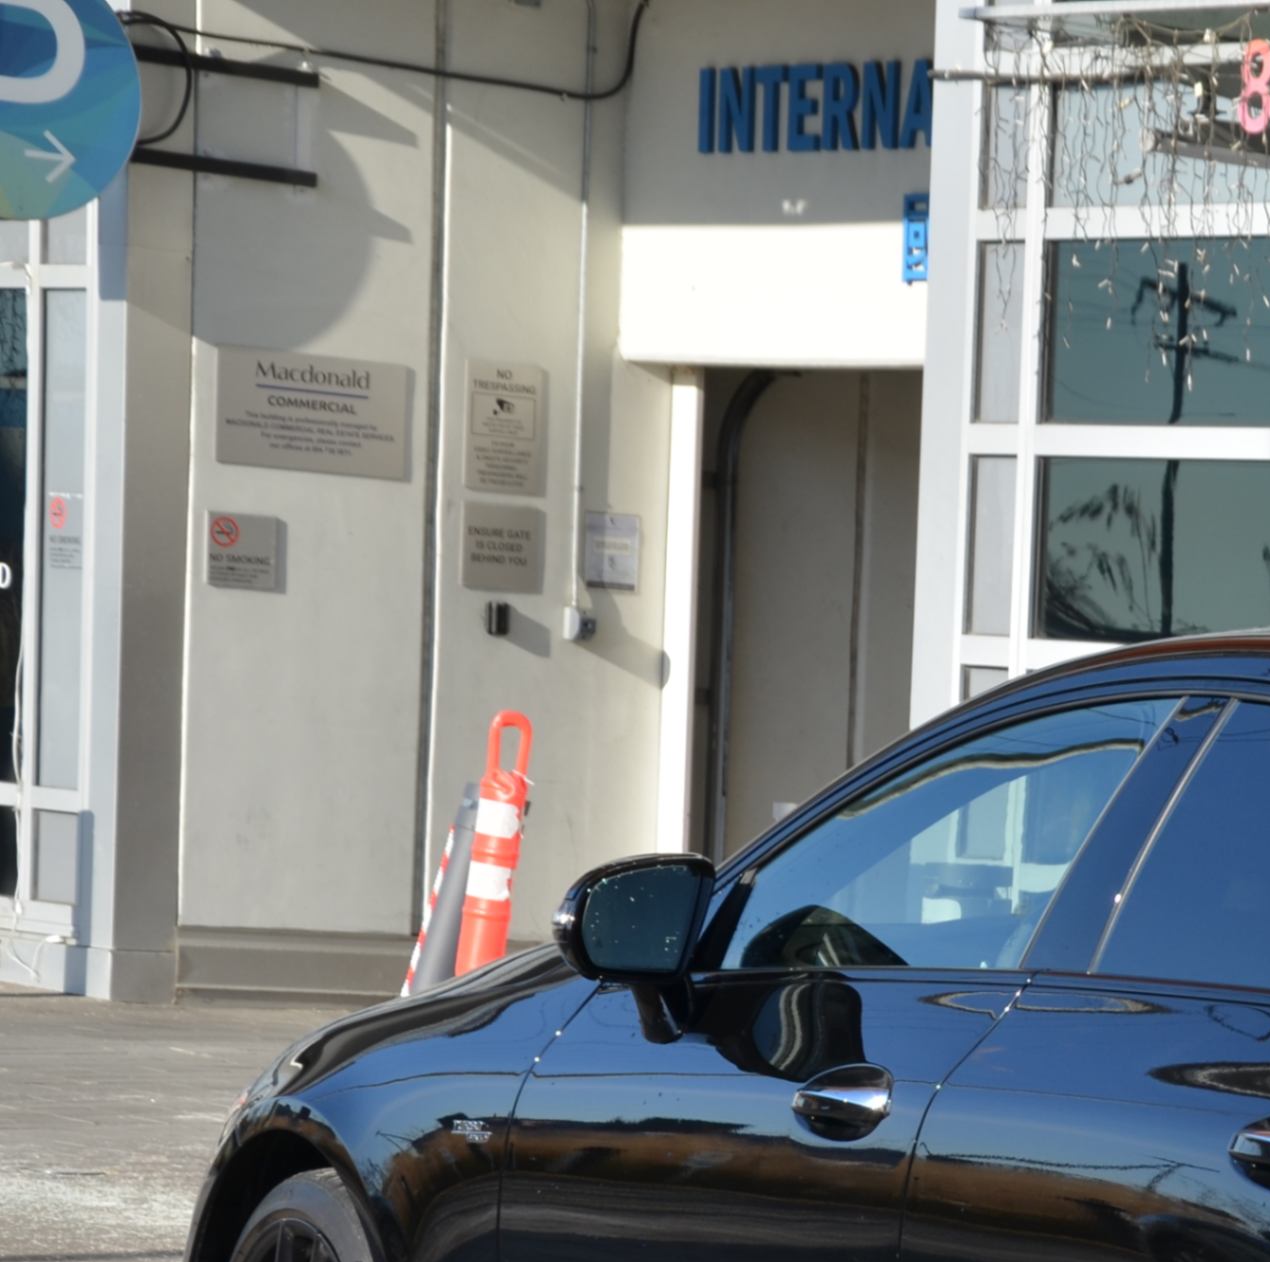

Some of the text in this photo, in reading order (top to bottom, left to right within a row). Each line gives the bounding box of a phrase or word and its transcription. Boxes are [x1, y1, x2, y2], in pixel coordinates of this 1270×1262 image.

[255, 361, 370, 389] Macdonald
[496, 368, 512, 380] NO
[474, 379, 536, 396] TRESPASSING
[267, 395, 357, 415] COMMERCIAL
[468, 525, 531, 540] ENSURE GATE
[508, 555, 527, 567] YOU
